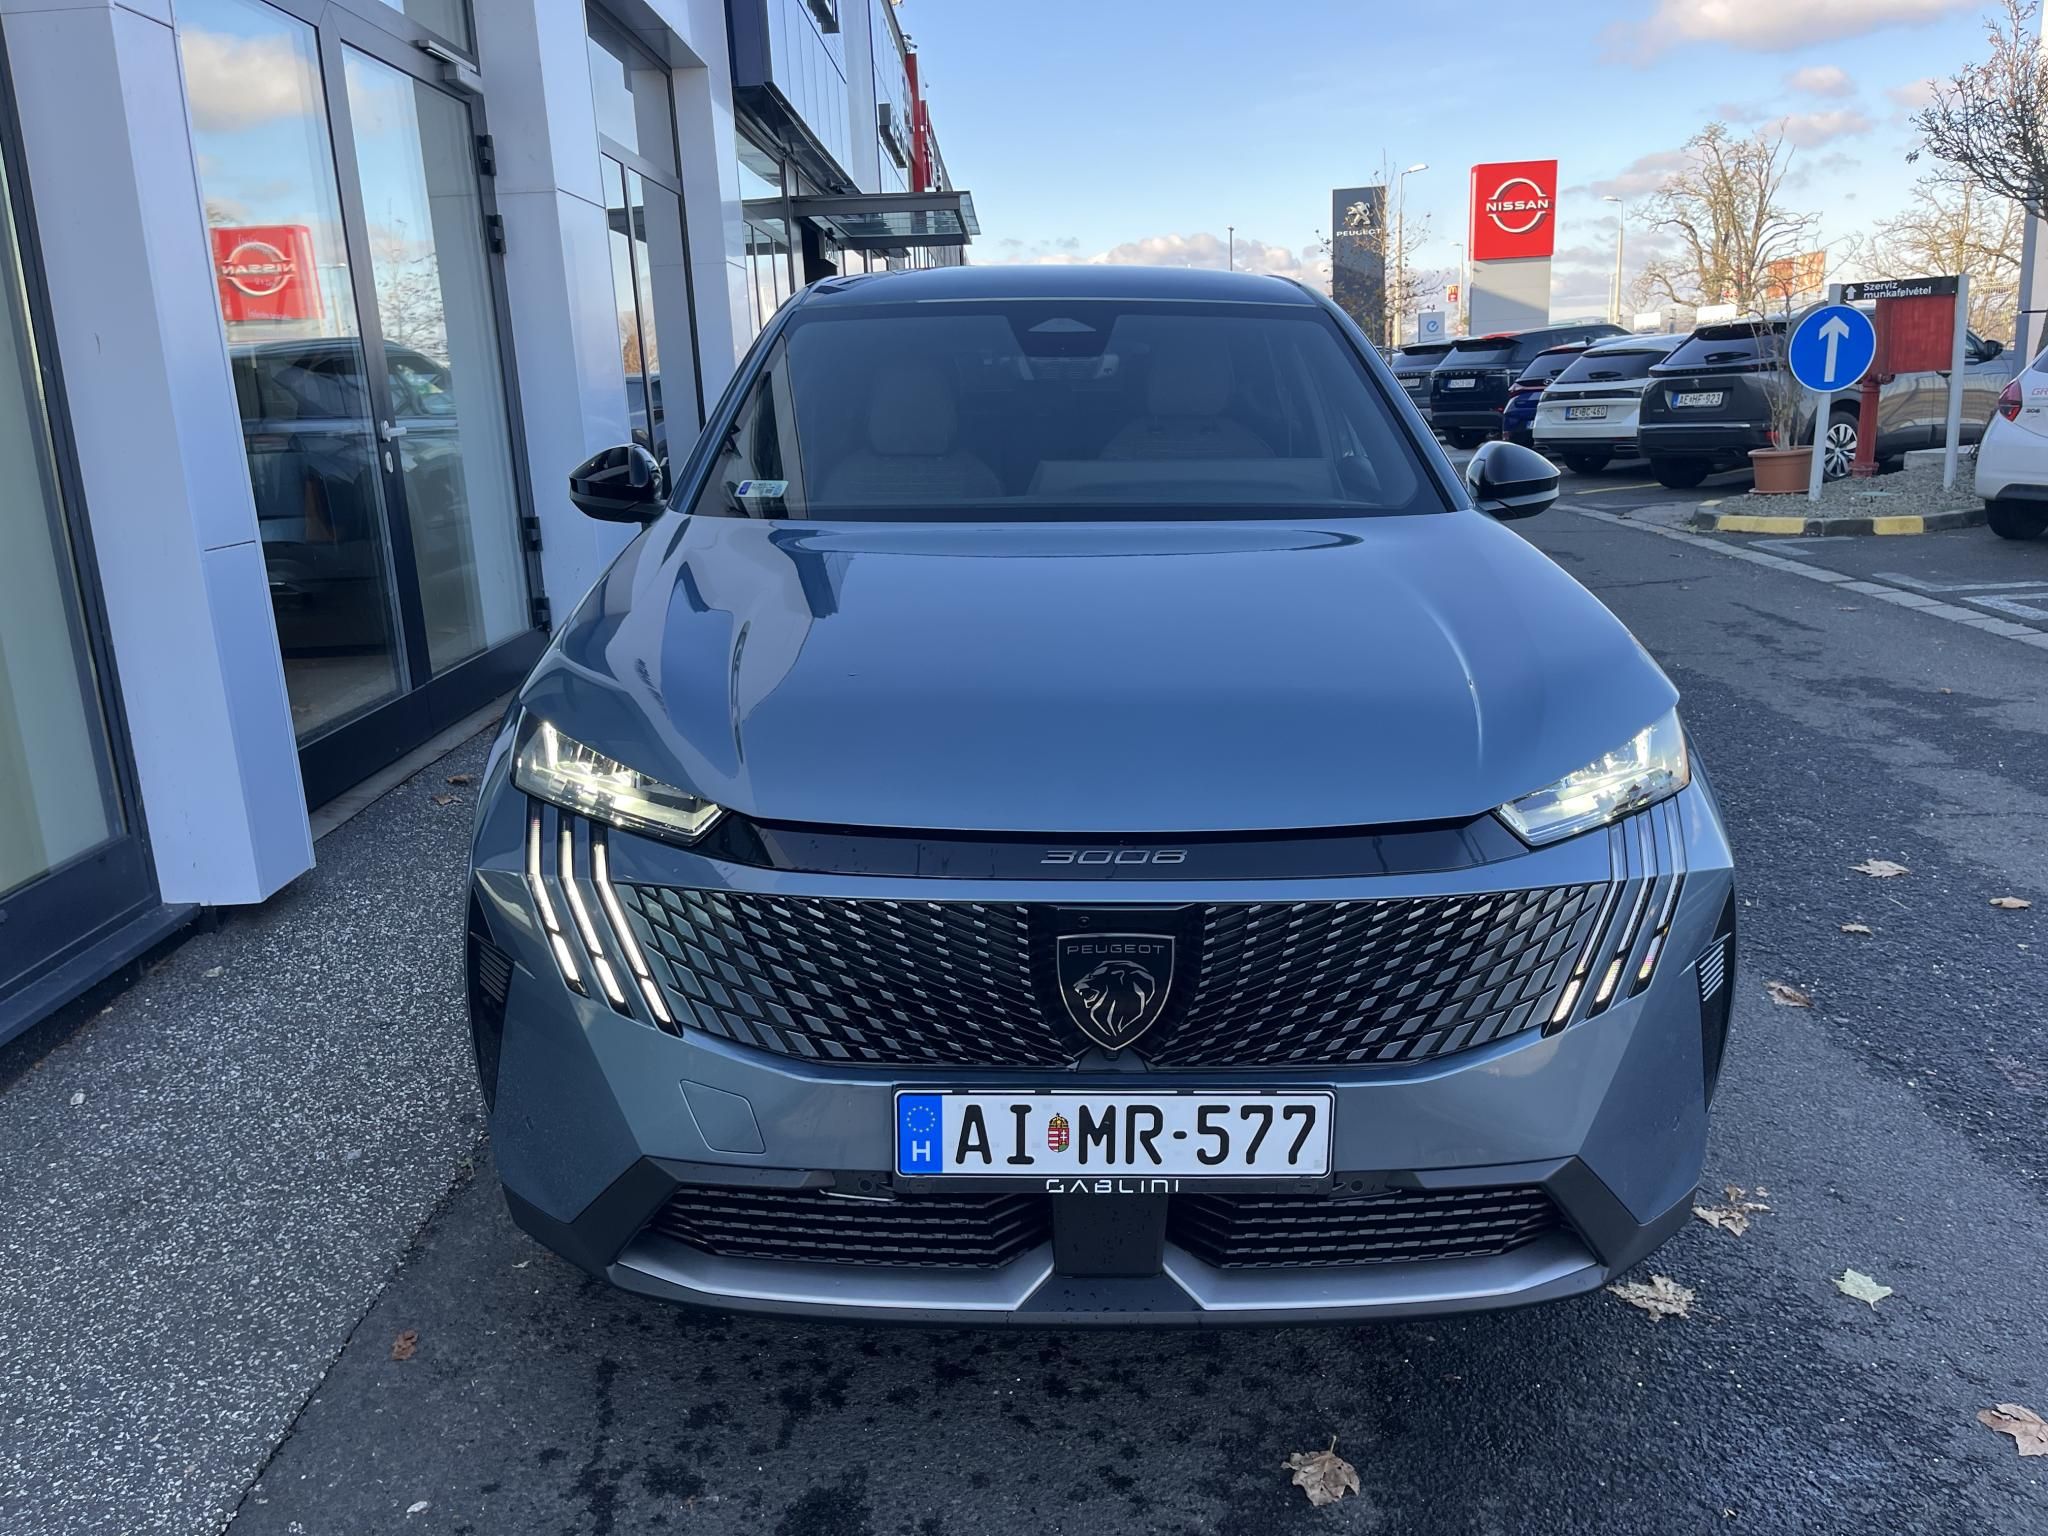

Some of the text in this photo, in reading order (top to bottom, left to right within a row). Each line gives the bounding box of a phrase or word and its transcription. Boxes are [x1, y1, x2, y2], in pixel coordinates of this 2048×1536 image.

[1485, 199, 1549, 212] NISSAN
[1863, 281, 1898, 292] Szerviz
[1863, 286, 1932, 299] munkafelvétel
[1040, 849, 1188, 865] 3008
[1066, 944, 1166, 955] PEUGEOT
[911, 1140, 931, 1162] H
[1045, 1178, 1179, 1194] GABLINI
